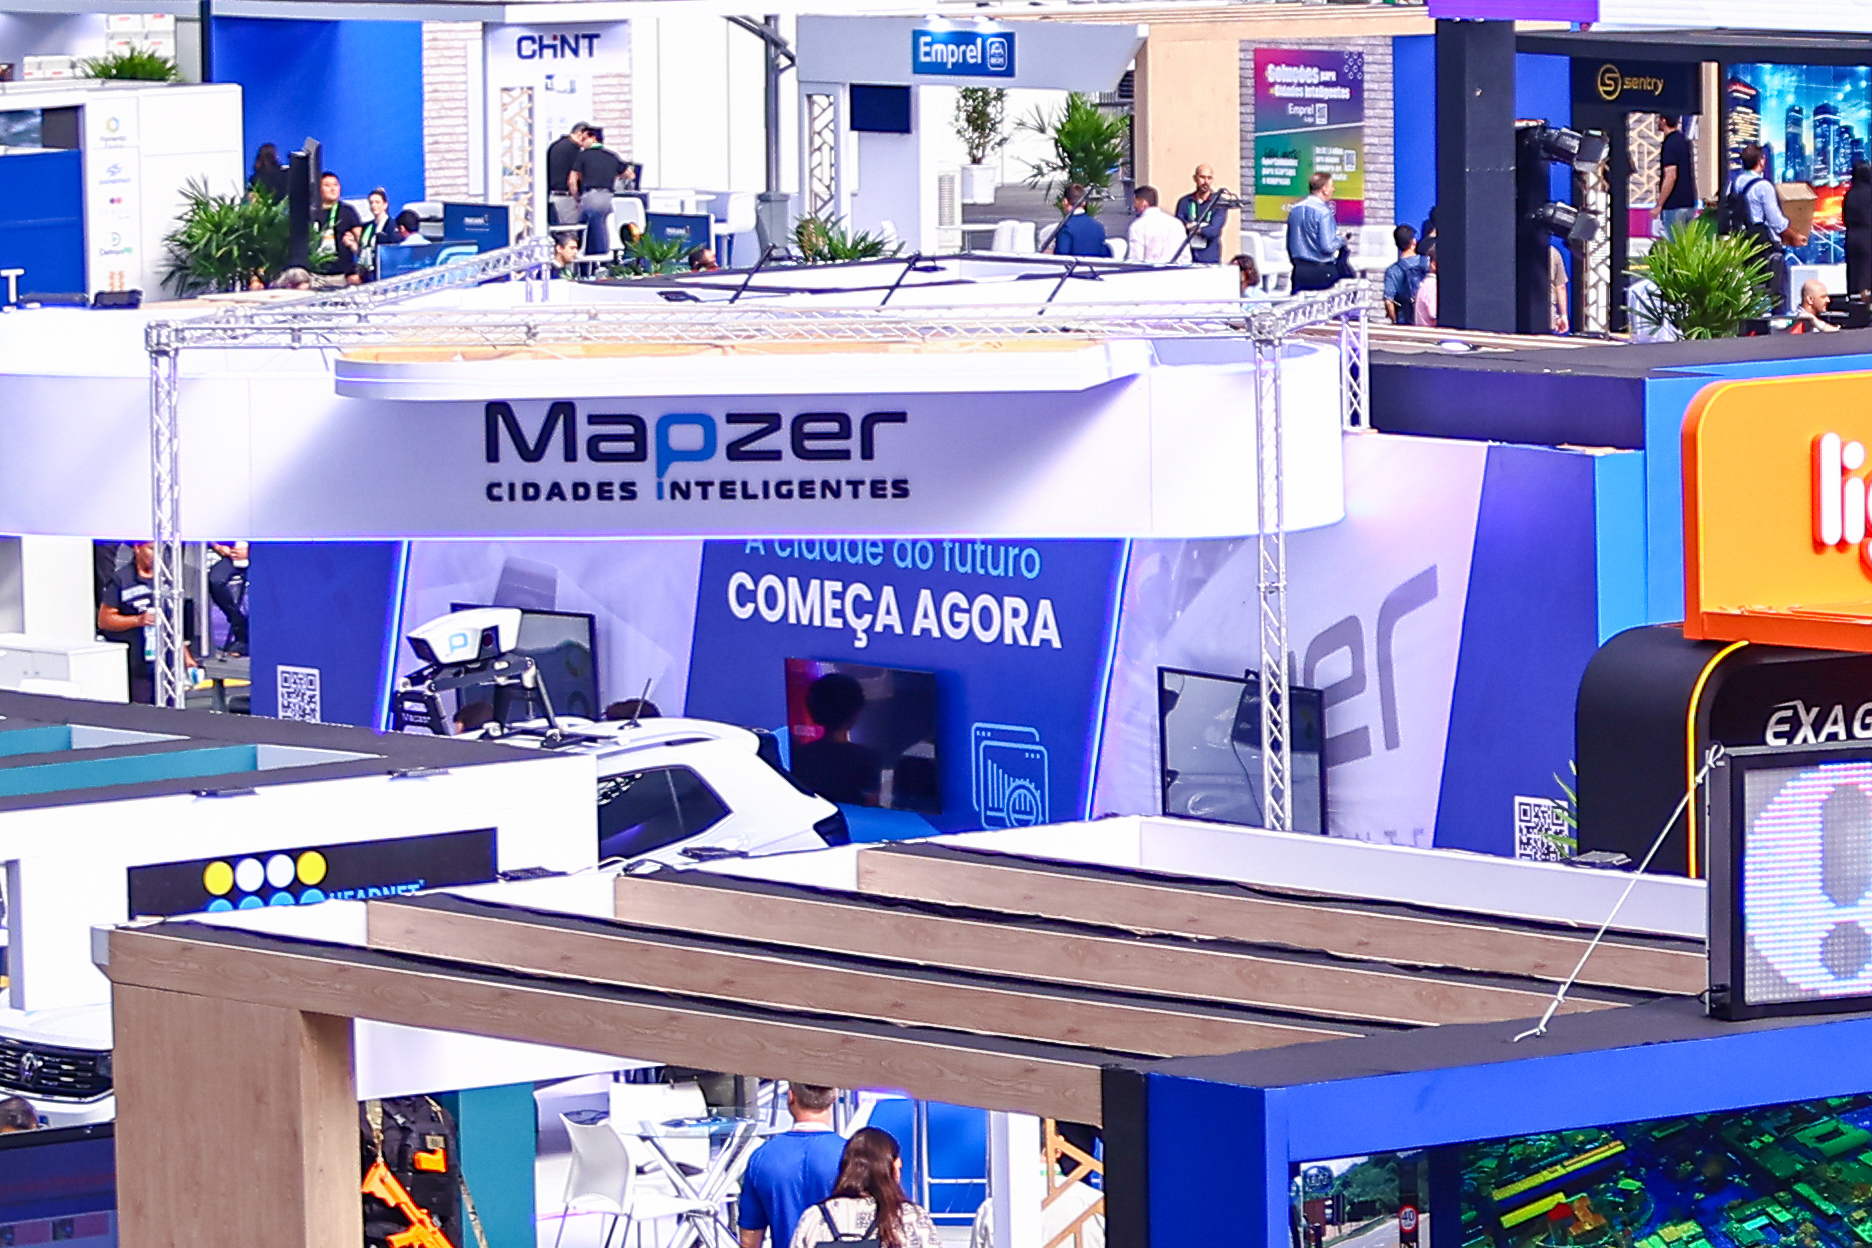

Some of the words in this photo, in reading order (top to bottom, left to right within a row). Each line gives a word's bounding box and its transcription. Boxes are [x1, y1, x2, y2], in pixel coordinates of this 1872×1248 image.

[919, 36, 982, 69] Emprel
[485, 401, 908, 480] Mapzer
[486, 482, 638, 501] CIDADES
[657, 480, 910, 501] INTELIGENTES
[728, 571, 905, 648] COMEÇA
[911, 588, 1063, 649] AGORA
